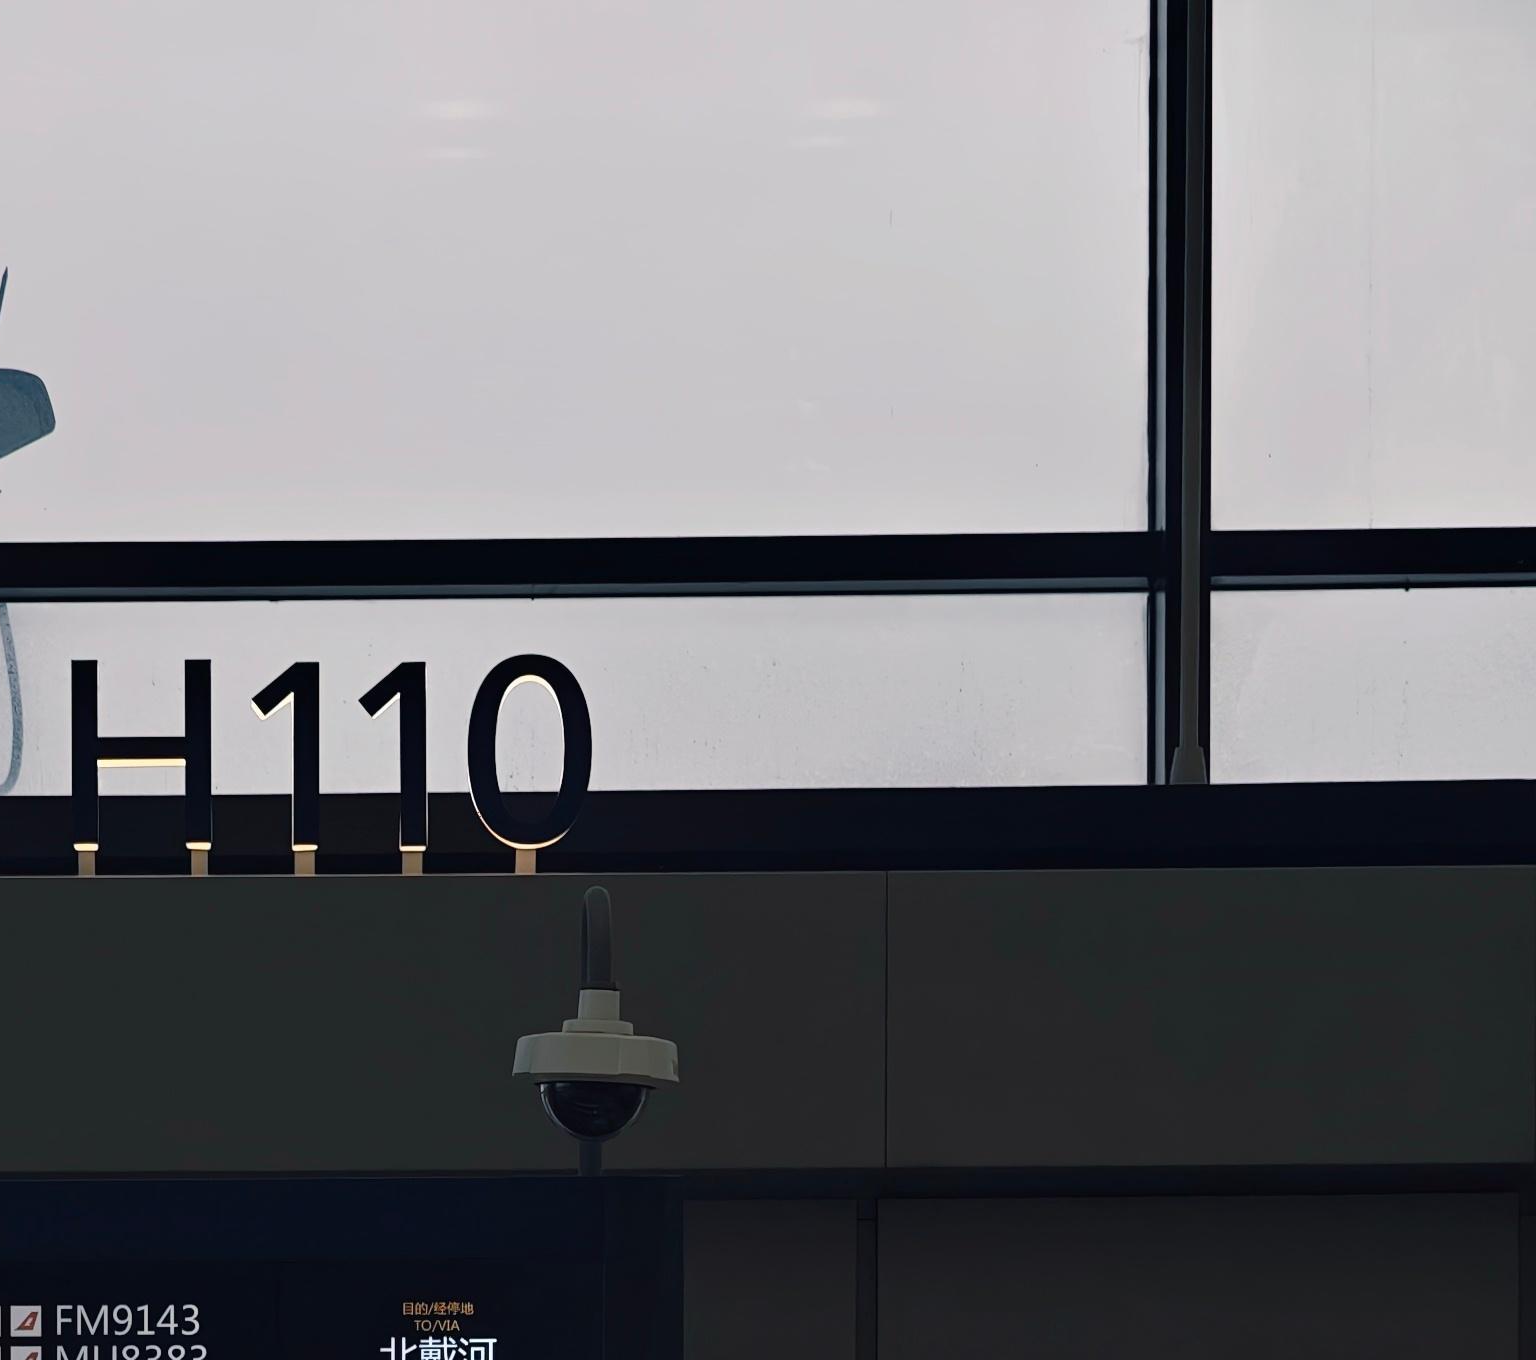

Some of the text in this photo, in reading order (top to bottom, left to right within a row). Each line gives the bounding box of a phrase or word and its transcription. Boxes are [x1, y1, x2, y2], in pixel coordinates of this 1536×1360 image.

[70, 654, 594, 852] H110
[57, 1304, 199, 1335] FM9143
[403, 1302, 474, 1315] 目的/经停地
[414, 1320, 460, 1332] TO/VIA
